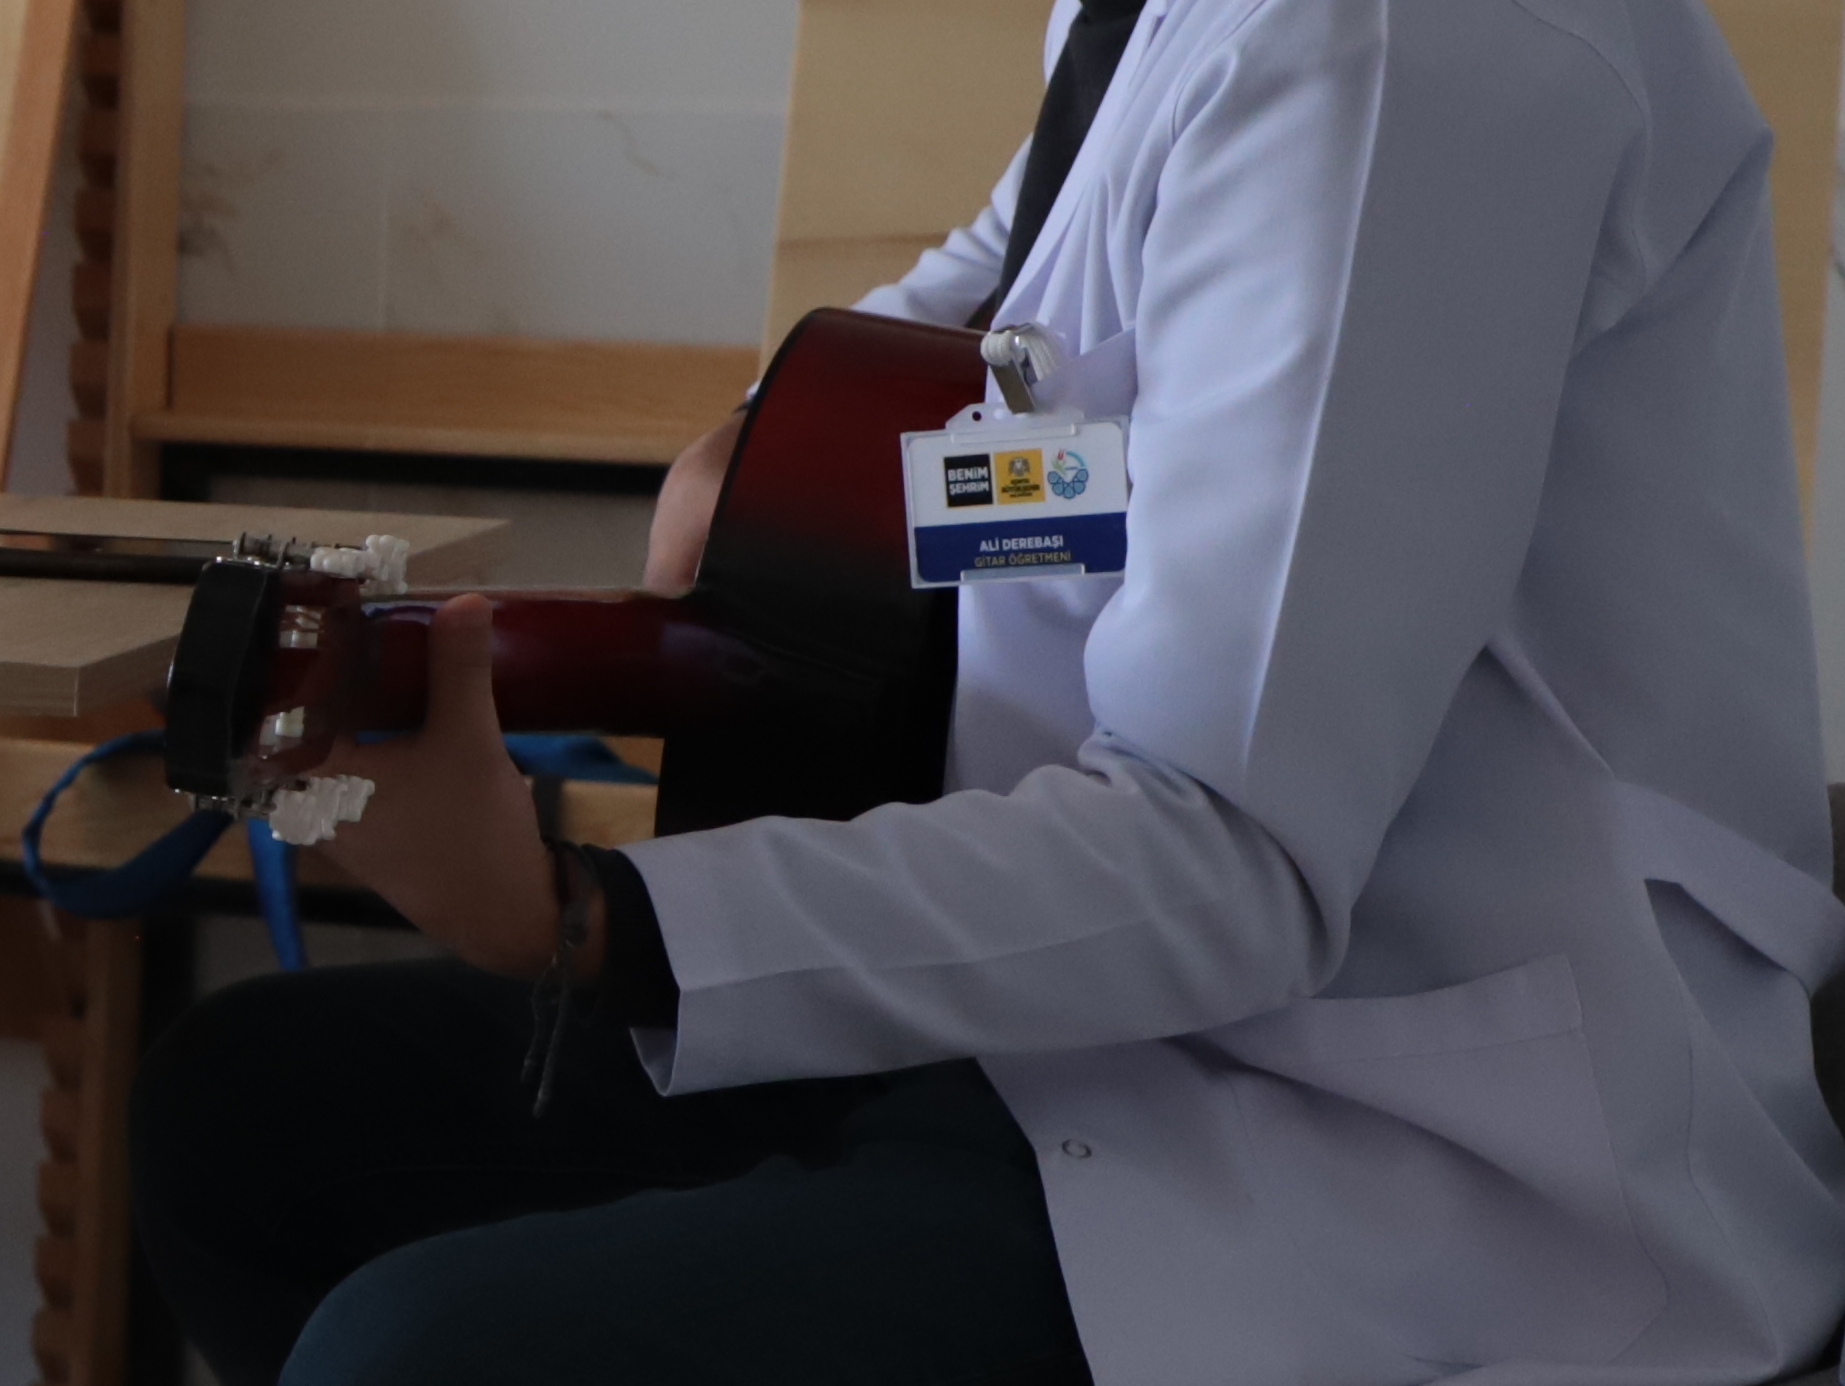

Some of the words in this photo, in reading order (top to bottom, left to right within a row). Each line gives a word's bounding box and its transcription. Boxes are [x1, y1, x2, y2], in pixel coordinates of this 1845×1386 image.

[947, 466, 989, 481] BENİM
[948, 481, 990, 496] ŞEHRİM
[979, 537, 1000, 552] ALİ
[1002, 534, 1064, 550] DEREBAŞI
[974, 554, 1006, 567] GİTAR
[1008, 551, 1072, 566] ÖĞRETMENİ
